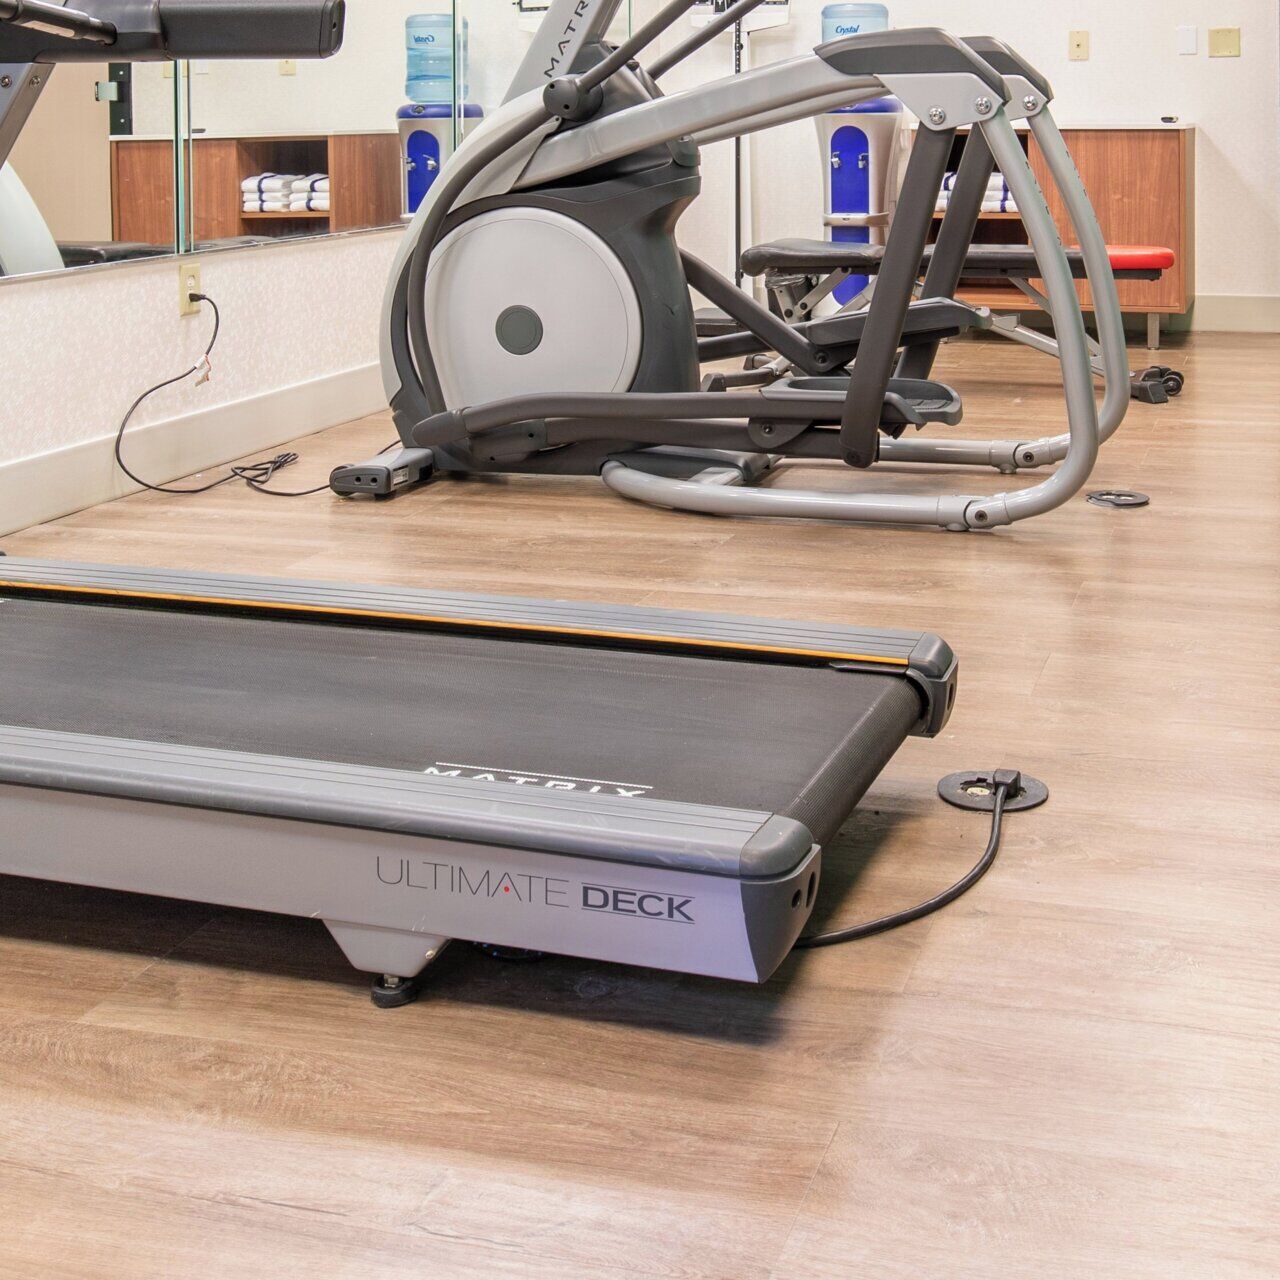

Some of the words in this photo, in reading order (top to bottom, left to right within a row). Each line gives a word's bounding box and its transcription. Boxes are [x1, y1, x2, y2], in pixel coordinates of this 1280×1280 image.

[835, 24, 860, 36] Crystal
[376, 856, 570, 908] ULTIMATE
[581, 885, 696, 922] DECK
